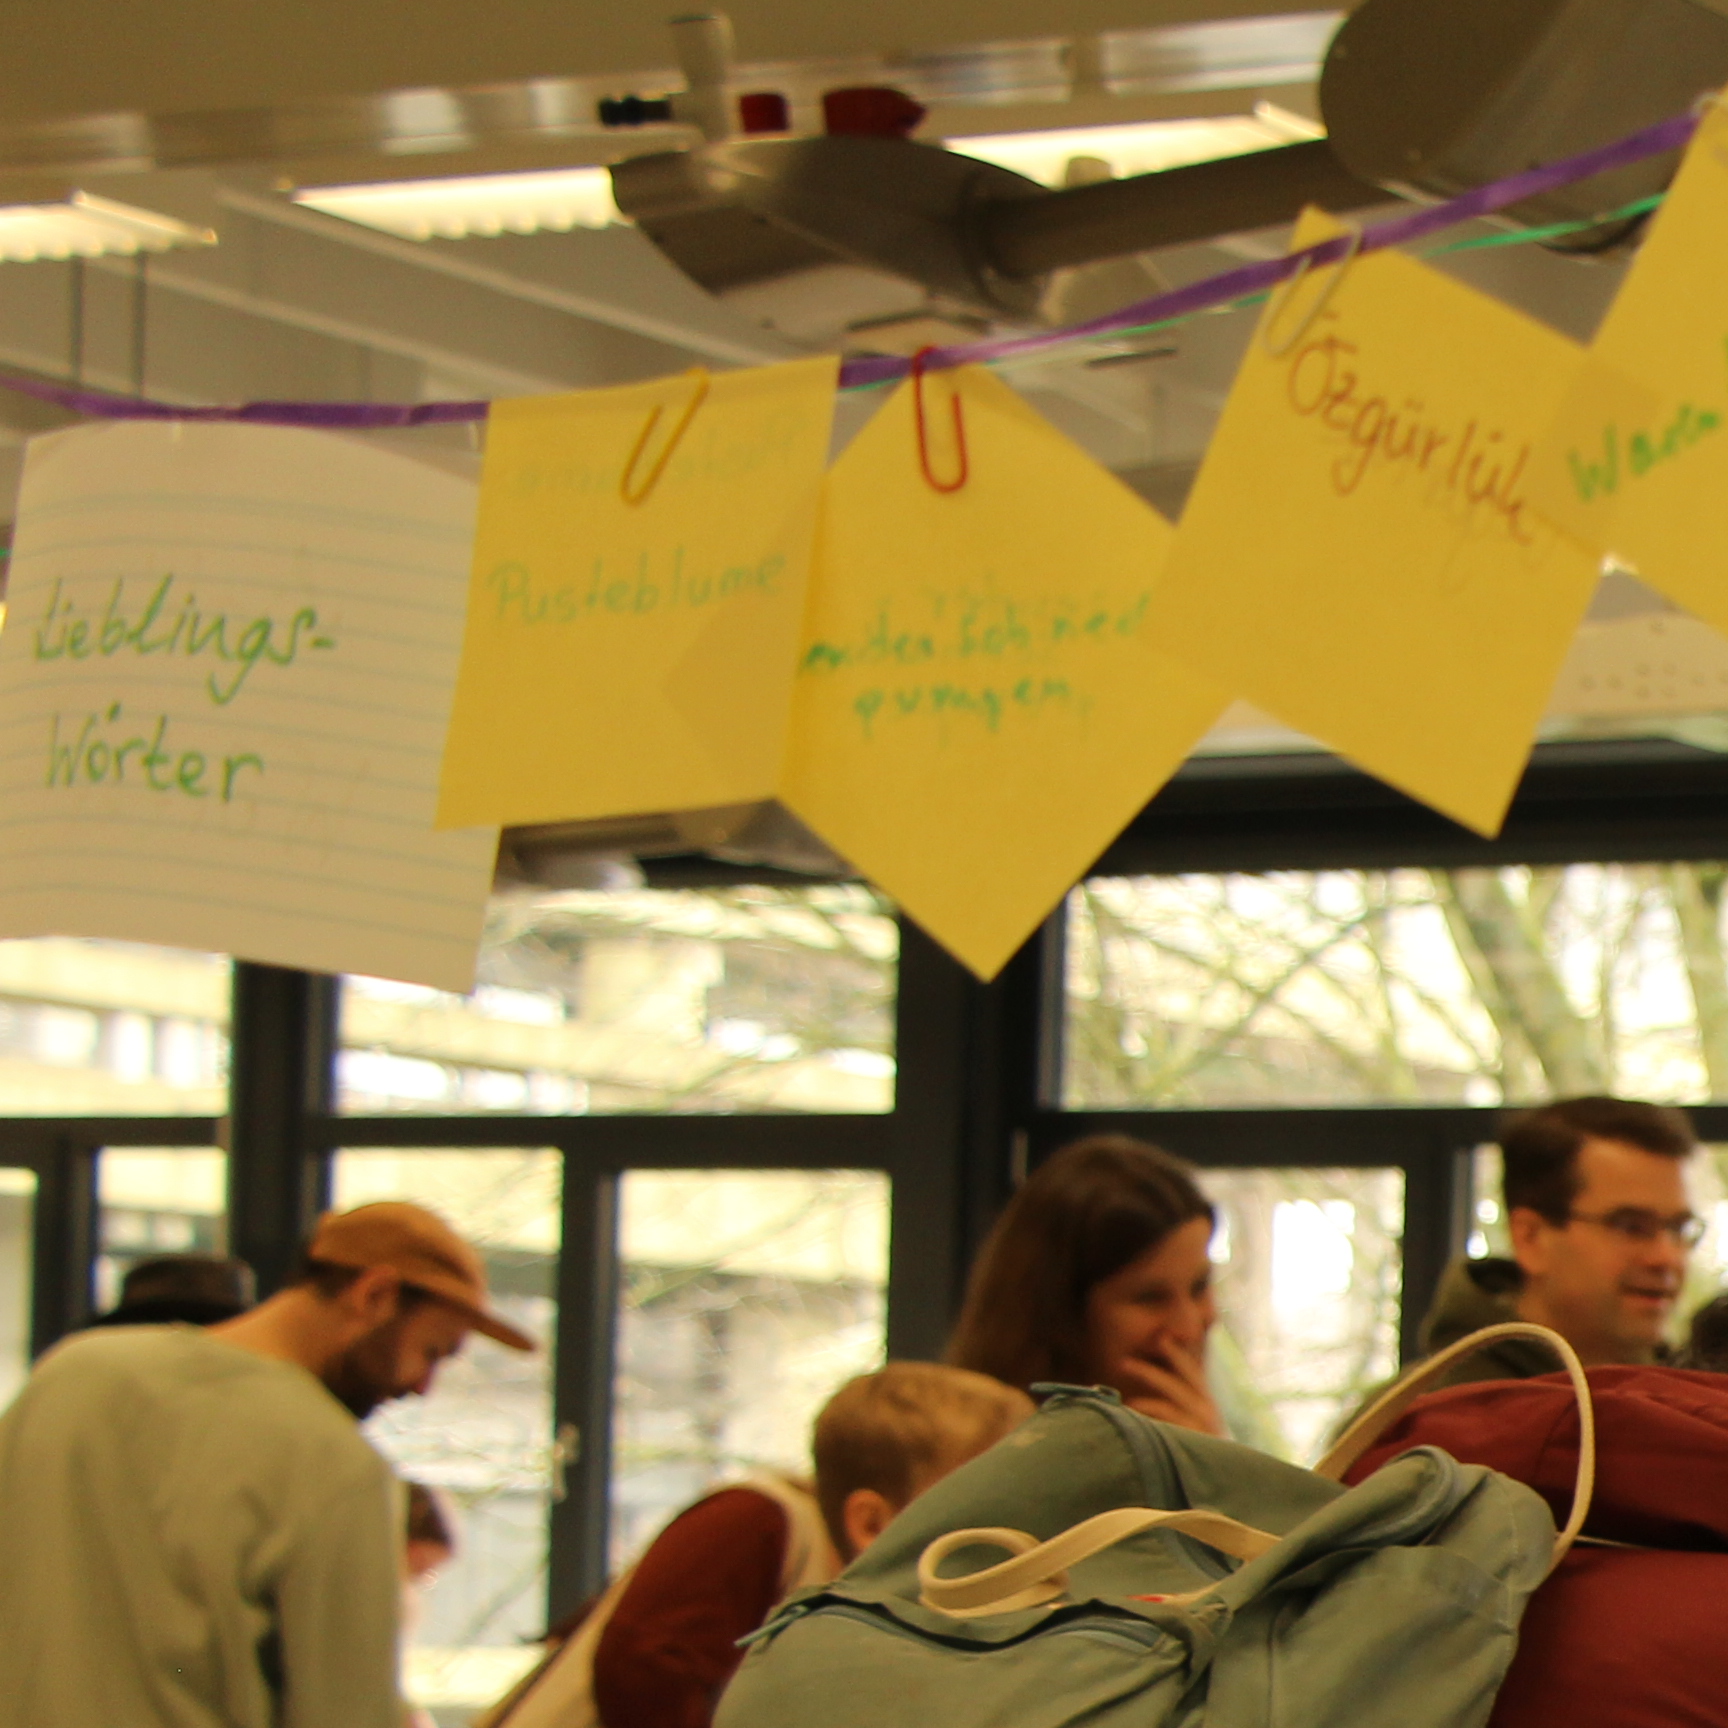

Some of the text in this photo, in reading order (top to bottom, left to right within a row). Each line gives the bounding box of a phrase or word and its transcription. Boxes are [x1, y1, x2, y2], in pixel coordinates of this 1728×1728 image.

[483, 546, 789, 627] Pusteblume
[33, 572, 336, 705] Lieblings-
[45, 701, 265, 804] Wörter
